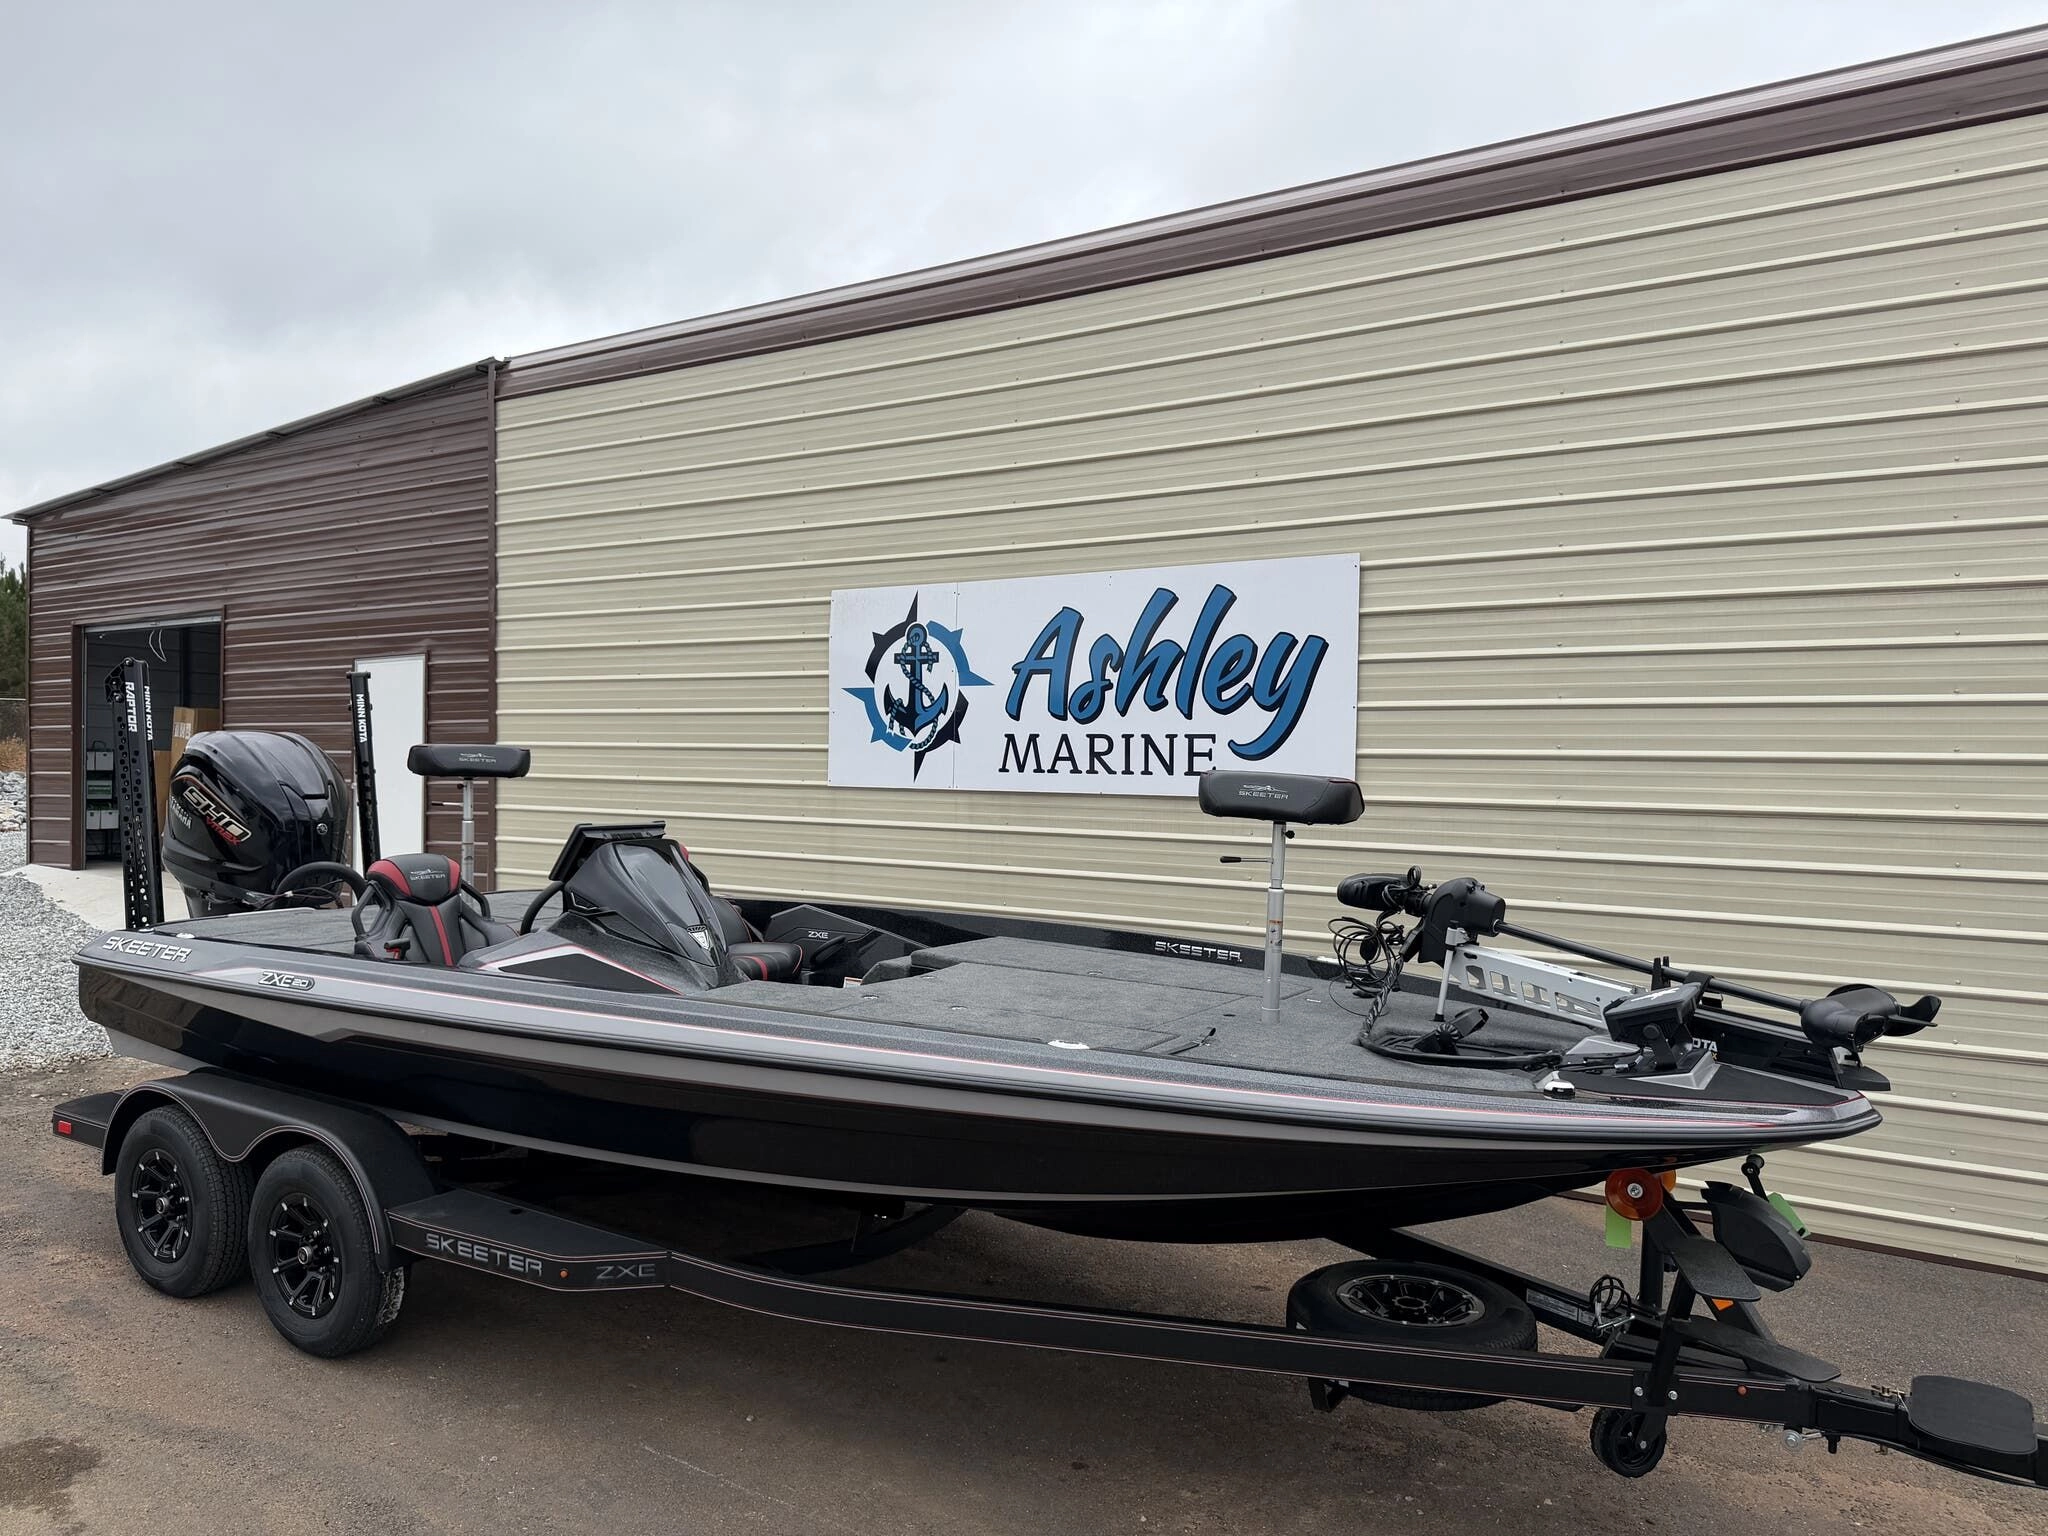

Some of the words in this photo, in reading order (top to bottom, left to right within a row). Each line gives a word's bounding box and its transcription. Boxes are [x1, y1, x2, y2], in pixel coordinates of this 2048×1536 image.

[1005, 583, 1329, 760] Ashley
[125, 681, 137, 732] RAPTOR
[356, 694, 366, 718] MINN
[358, 719, 368, 743] KOTA
[998, 732, 1217, 777] MARINE
[1238, 789, 1289, 800] SKEETER
[183, 786, 252, 842] SHO
[808, 930, 829, 939] ZXE
[102, 935, 192, 964] SKEETER
[1154, 941, 1242, 962] SKEETER
[259, 971, 295, 988] ZXE
[1692, 1037, 1719, 1052] OTA
[425, 1233, 543, 1277] SKEETER
[596, 1263, 657, 1280] ZXE
